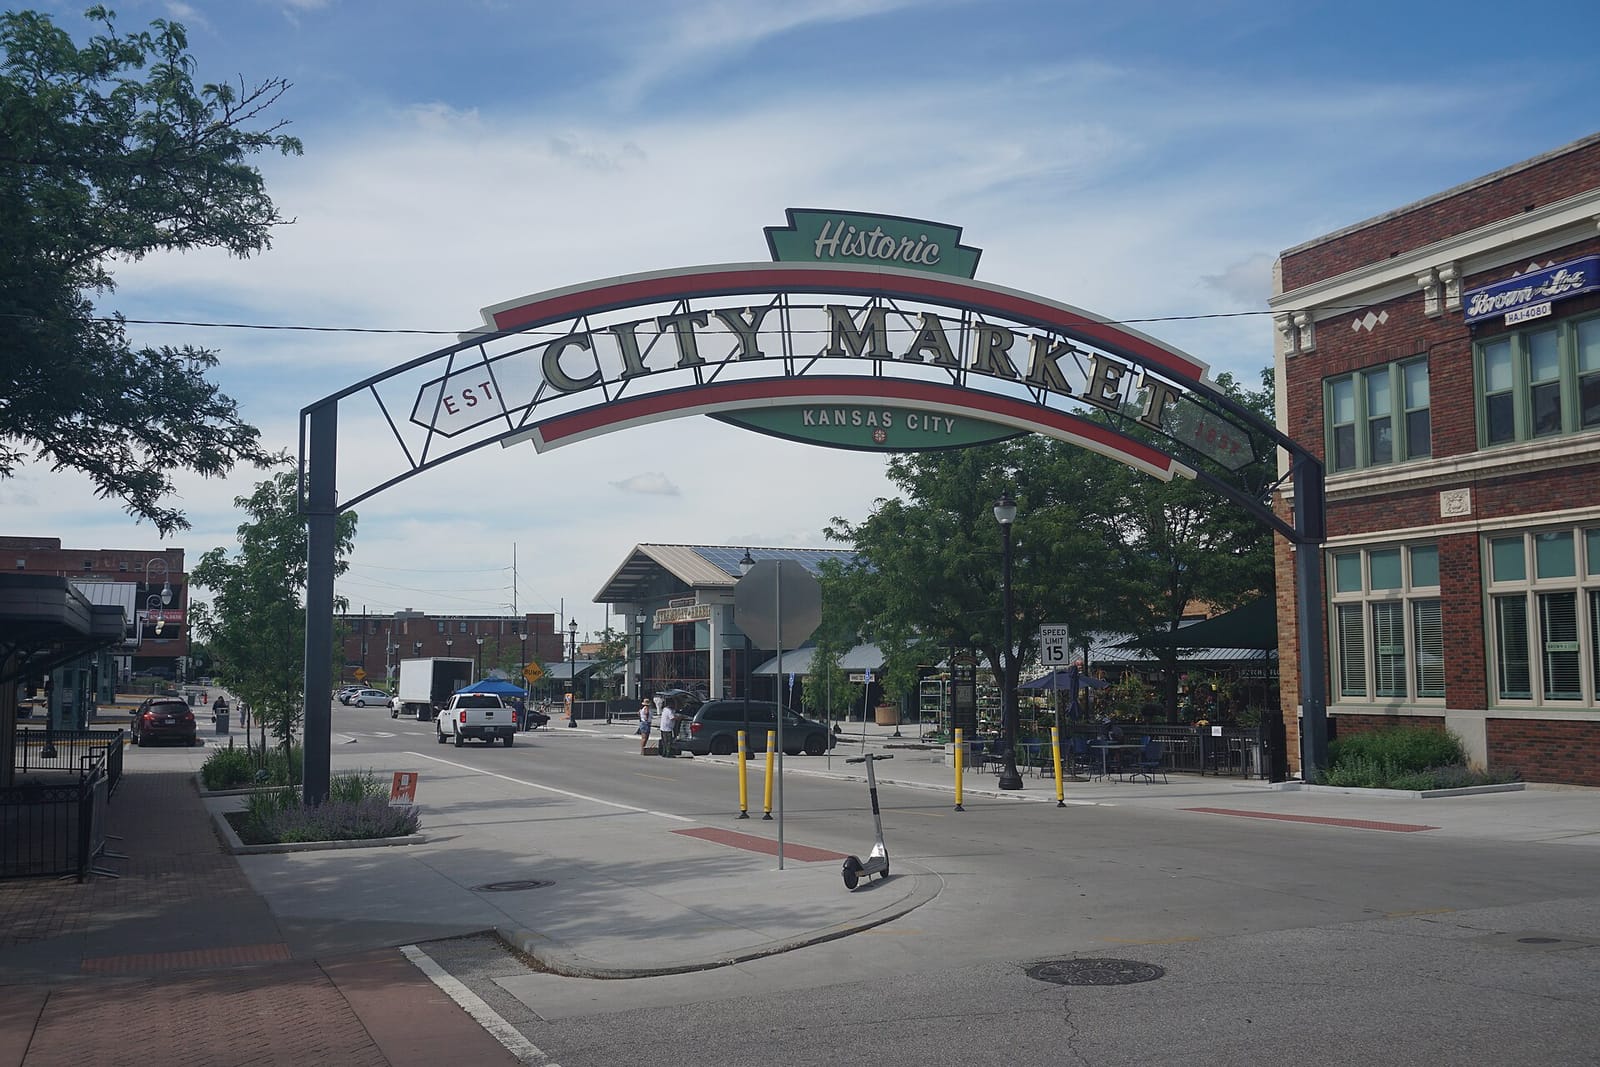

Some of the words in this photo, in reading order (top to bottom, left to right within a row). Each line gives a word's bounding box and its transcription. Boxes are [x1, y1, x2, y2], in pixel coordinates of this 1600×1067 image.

[815, 220, 940, 265] Historic
[1467, 286, 1534, 316] Brown
[1542, 269, 1586, 296] Loe
[540, 305, 766, 393] CITY
[824, 304, 1182, 432] MARKET
[443, 381, 492, 415] EST
[803, 409, 892, 427] KANSAS
[906, 413, 955, 433] CITY
[1045, 637, 1063, 645] LIMIT
[1046, 646, 1064, 661] 15
